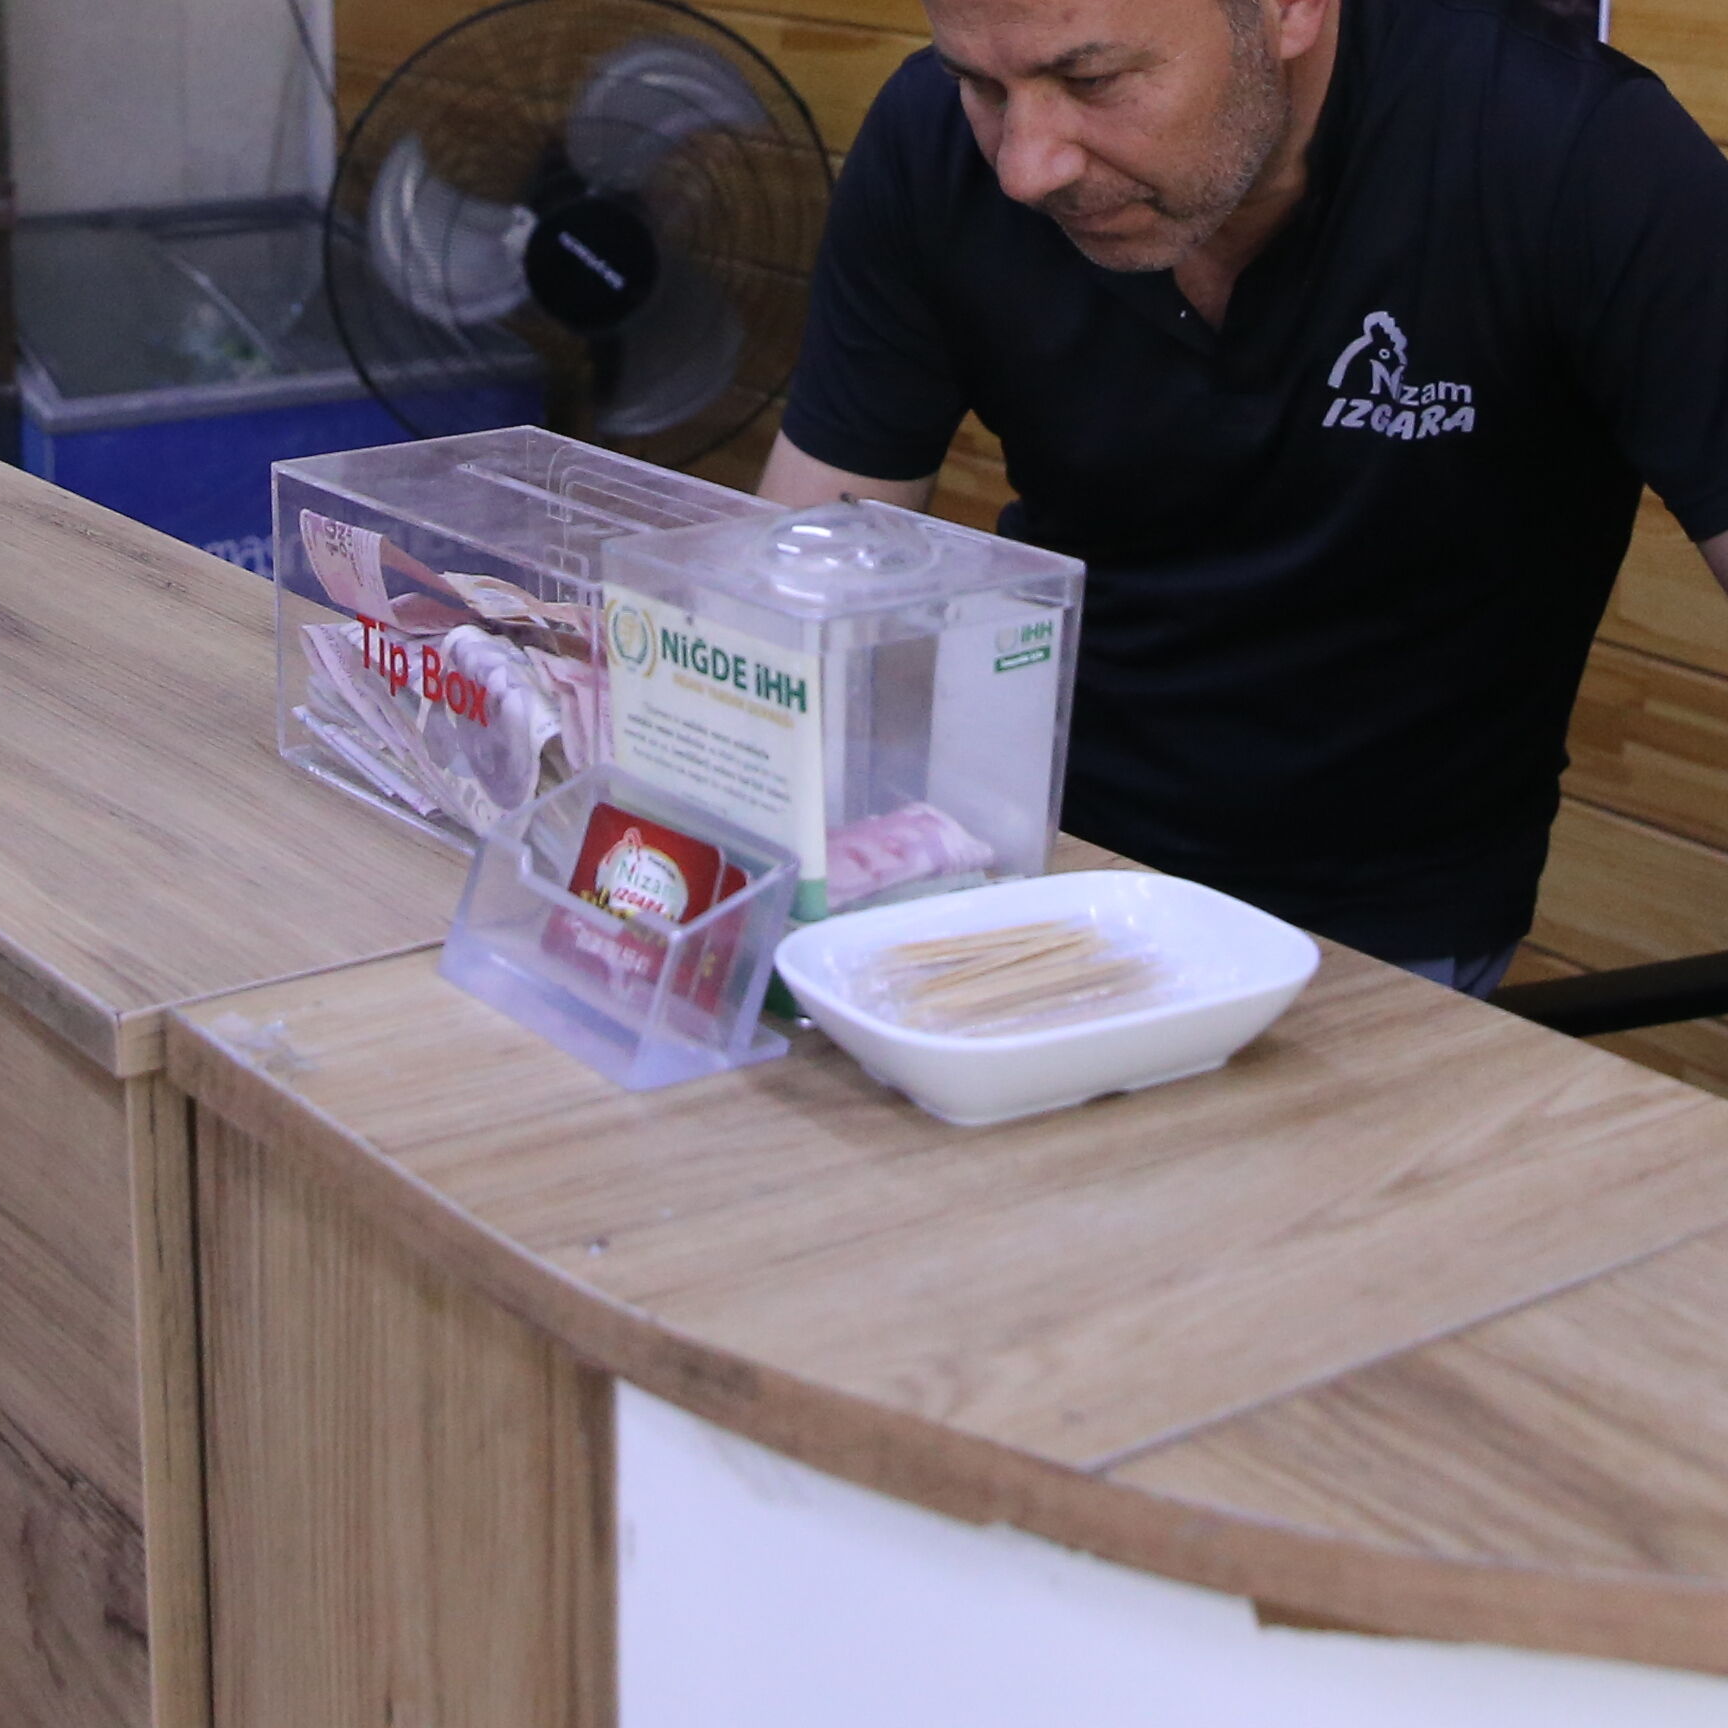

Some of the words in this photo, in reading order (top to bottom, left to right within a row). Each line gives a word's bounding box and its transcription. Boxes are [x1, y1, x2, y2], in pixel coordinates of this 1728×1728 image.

[1322, 397, 1475, 440] IZGARA
[356, 614, 409, 697] Tip
[423, 644, 488, 727] Box
